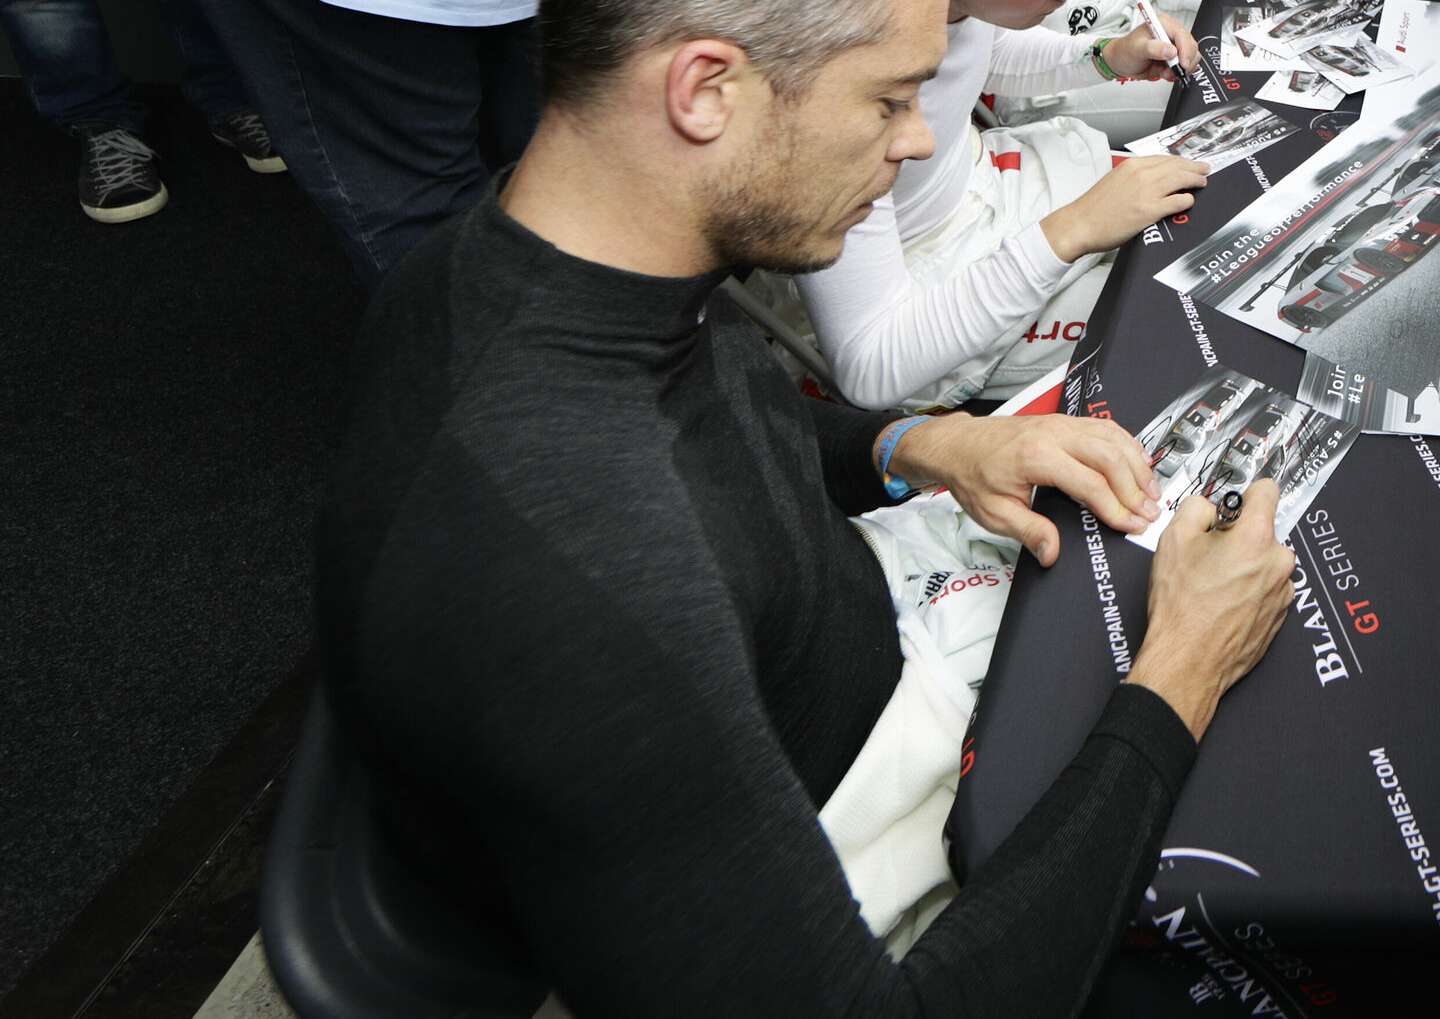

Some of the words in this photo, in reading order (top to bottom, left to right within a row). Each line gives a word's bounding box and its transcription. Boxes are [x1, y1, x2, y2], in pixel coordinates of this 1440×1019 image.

[1222, 76, 1241, 91] GT
[1211, 160, 1364, 284] #LeagueofPerformance
[1200, 248, 1233, 275] Join
[1234, 229, 1260, 248] the
[1327, 430, 1344, 448] #5
[1306, 509, 1360, 592] SERIES
[1345, 600, 1379, 634] GT
